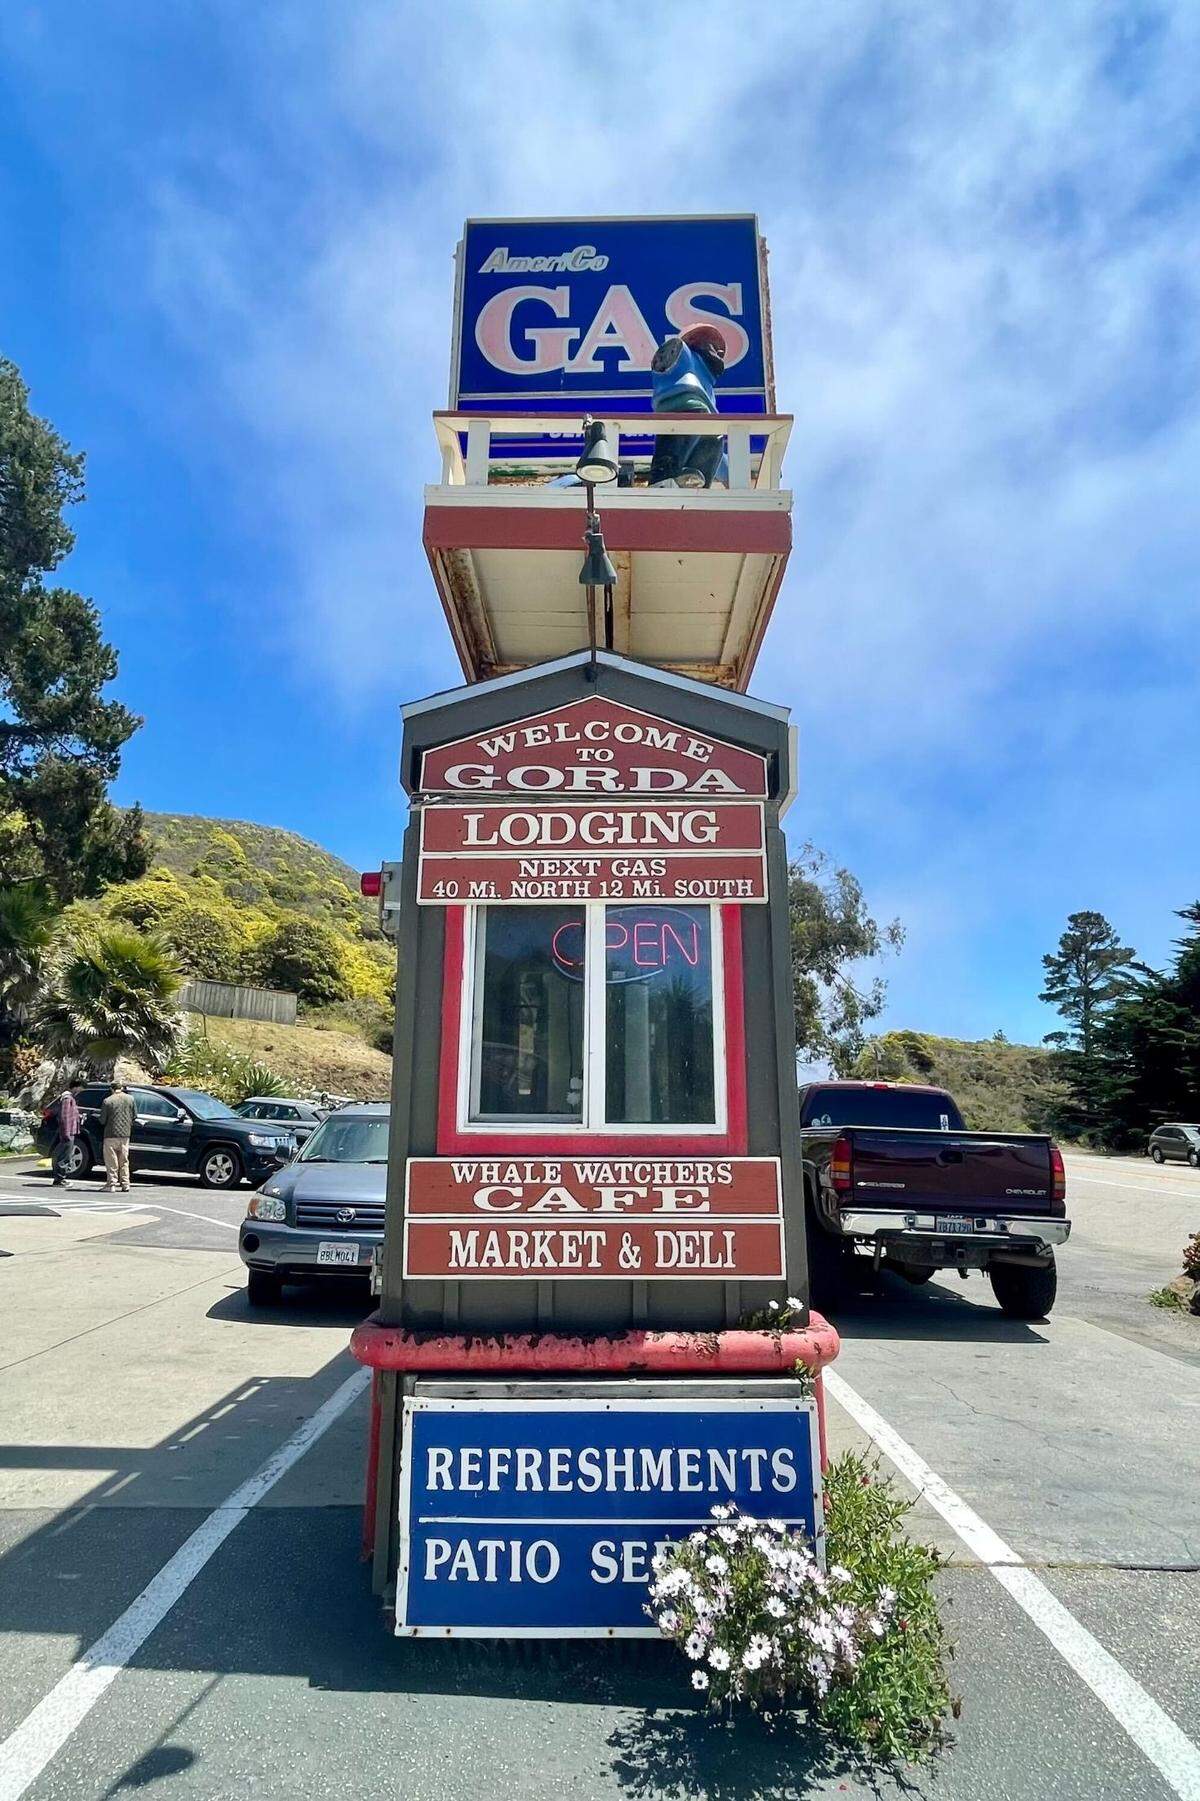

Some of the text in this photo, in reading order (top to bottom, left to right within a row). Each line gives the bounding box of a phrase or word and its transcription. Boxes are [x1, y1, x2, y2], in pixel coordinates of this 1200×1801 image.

[474, 282, 750, 376] GAS
[477, 720, 714, 763] WELCOME
[576, 748, 615, 762] TO
[444, 763, 746, 792] GORDA
[462, 810, 721, 846] LODGING
[518, 859, 667, 877] NEXT GAS
[432, 880, 459, 897] 40
[510, 881, 591, 897] NORTH
[600, 880, 624, 897] 12
[674, 879, 754, 898] SOUTH
[450, 1162, 733, 1184] WHALE WATCHERS
[472, 1185, 711, 1213] CAFE
[448, 1229, 737, 1269] MARKET & DELI
[425, 1446, 798, 1493] REFRESHMENTS
[423, 1538, 561, 1584] PATIO
